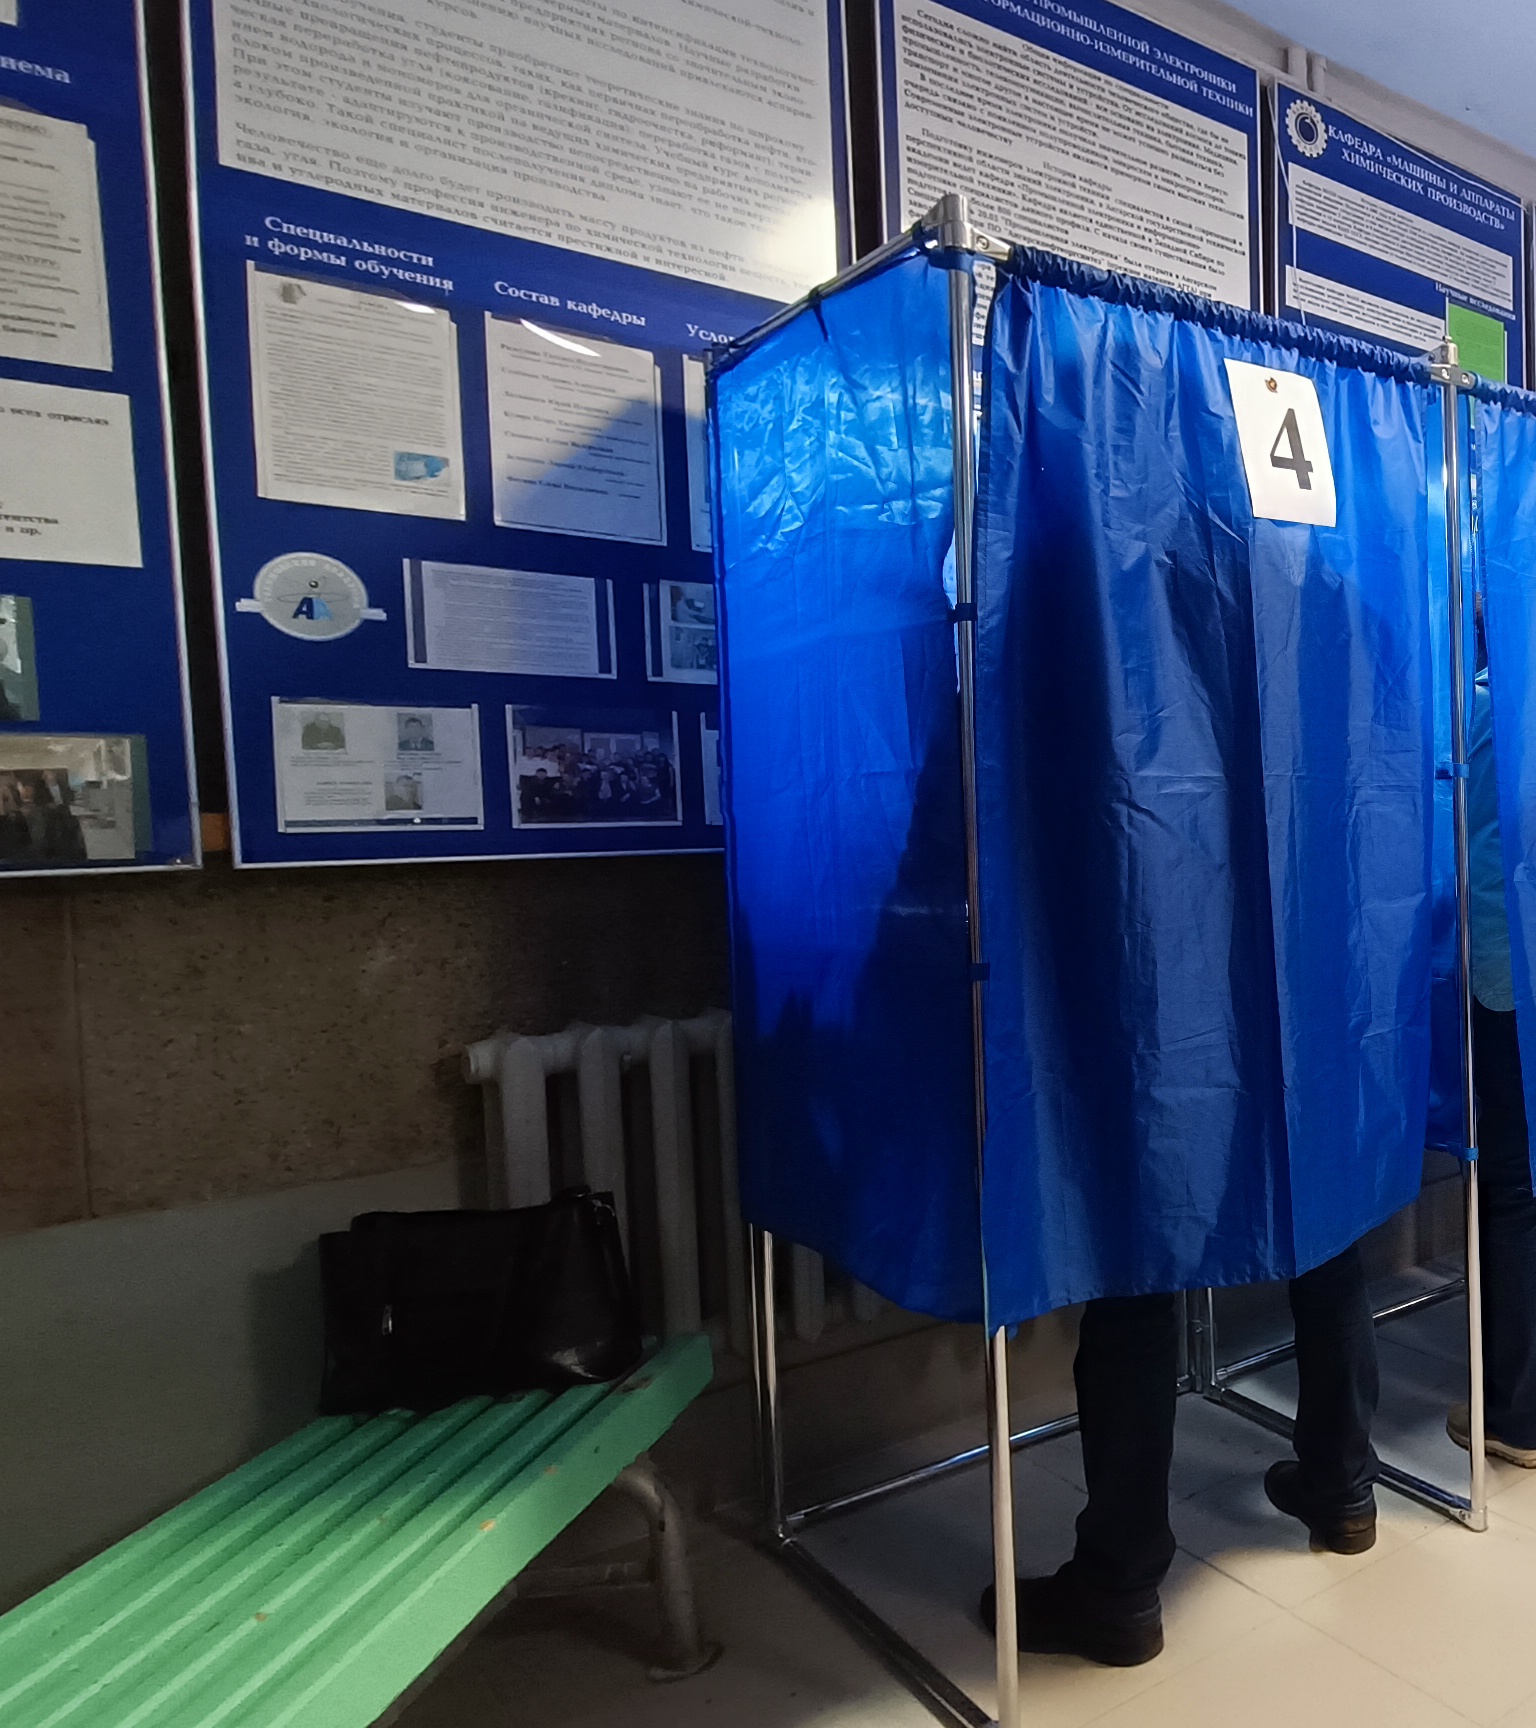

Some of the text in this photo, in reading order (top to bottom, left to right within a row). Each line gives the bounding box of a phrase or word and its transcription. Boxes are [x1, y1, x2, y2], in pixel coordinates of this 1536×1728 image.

[1153, 47, 1237, 94] ЭЛЕКТРОНИКИ
[1202, 86, 1254, 118] ТЕХНИКИ
[1328, 124, 1384, 160] КАФЕДРА
[1386, 152, 1447, 190] «МАШИНЫ
[1450, 180, 1458, 194] И
[1460, 186, 1516, 222] АППАРАТЫ
[1341, 147, 1506, 231] ХИМИЧЕСКИХ ПРОИЗВОДСТВ»
[245, 232, 454, 293] и формы обучения
[265, 215, 434, 267] Специальности
[495, 280, 646, 327] Состав кафедры
[1270, 408, 1313, 490] 4
